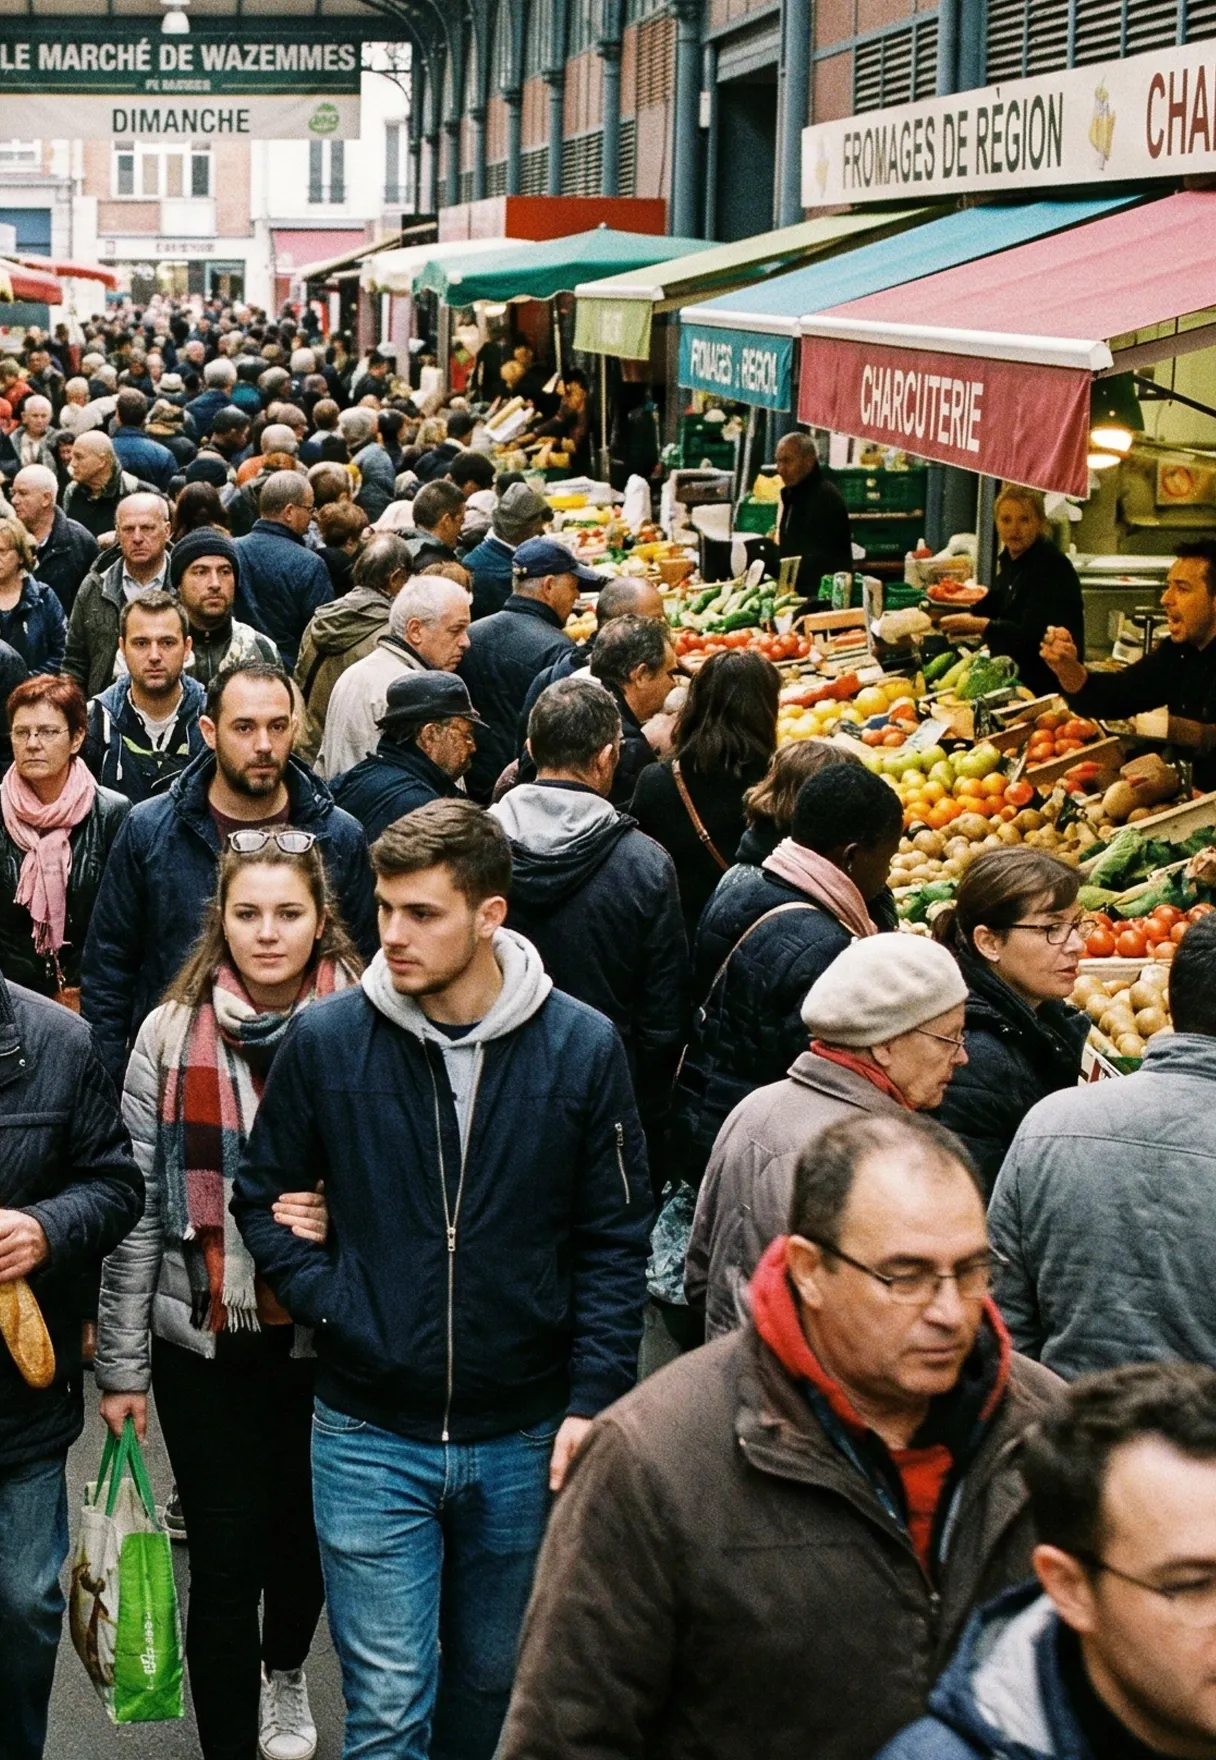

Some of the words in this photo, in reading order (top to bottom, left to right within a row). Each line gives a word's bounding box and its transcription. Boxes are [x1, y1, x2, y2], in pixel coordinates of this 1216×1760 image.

[0, 43, 31, 71] LE
[38, 38, 152, 71] MARCHÉ
[159, 43, 194, 71] DE
[201, 43, 355, 71] WAZEMMES
[112, 108, 250, 134] DIMANCHE
[842, 115, 936, 190] FROMAGES
[942, 109, 969, 179] DE
[1146, 64, 1216, 159] CHA
[861, 364, 984, 453] CHARCUTERIE
